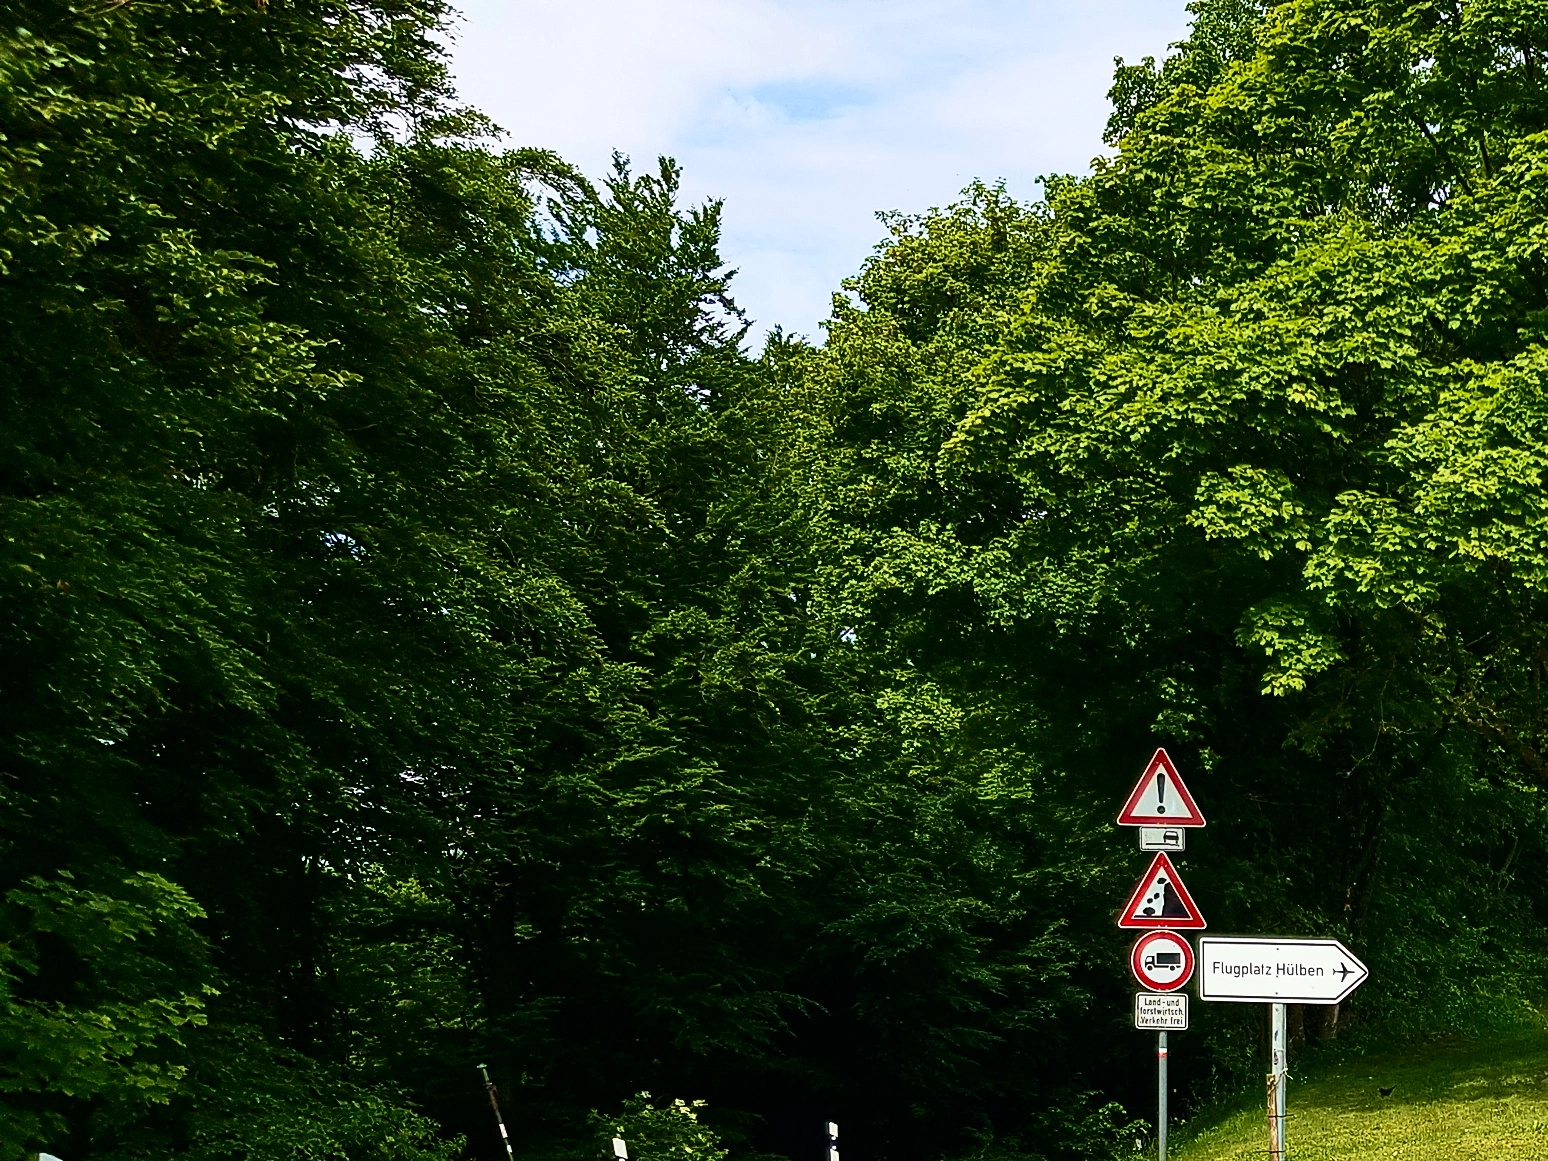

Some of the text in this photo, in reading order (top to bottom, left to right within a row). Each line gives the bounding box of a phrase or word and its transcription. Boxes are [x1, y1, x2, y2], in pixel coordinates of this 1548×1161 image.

[1213, 961, 1324, 978] Flugplatz Hülben
[1140, 1016, 1183, 1025] Verkehr frei
